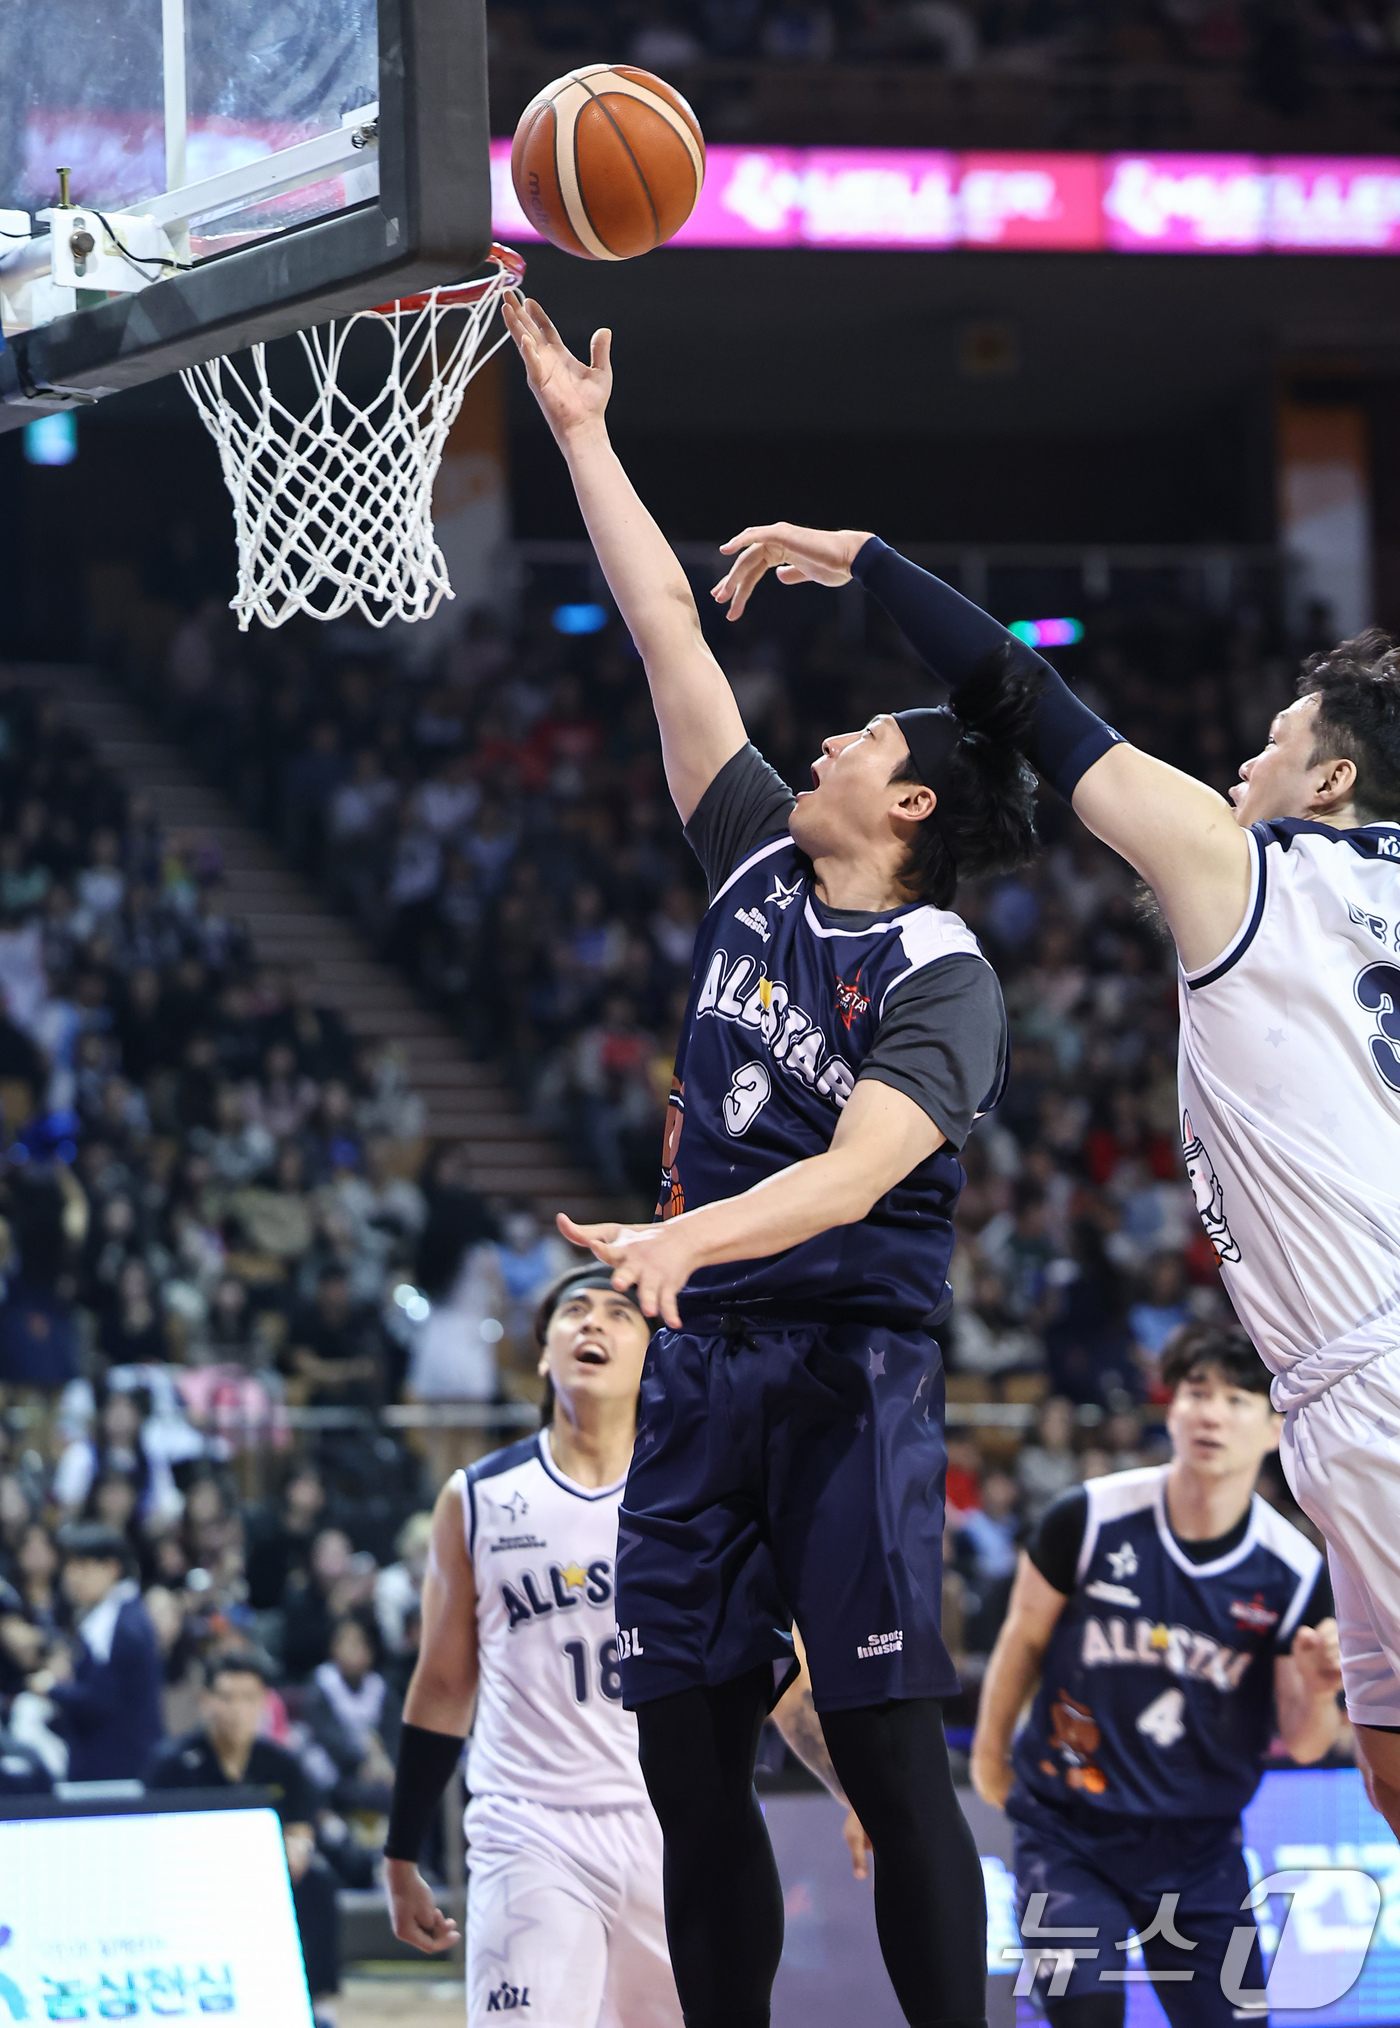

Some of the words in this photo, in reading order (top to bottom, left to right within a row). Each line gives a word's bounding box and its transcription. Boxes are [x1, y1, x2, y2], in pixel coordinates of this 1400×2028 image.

[722, 1060, 772, 1137] 3
[562, 1637, 622, 1704] 18
[1136, 1687, 1186, 1748] 4
